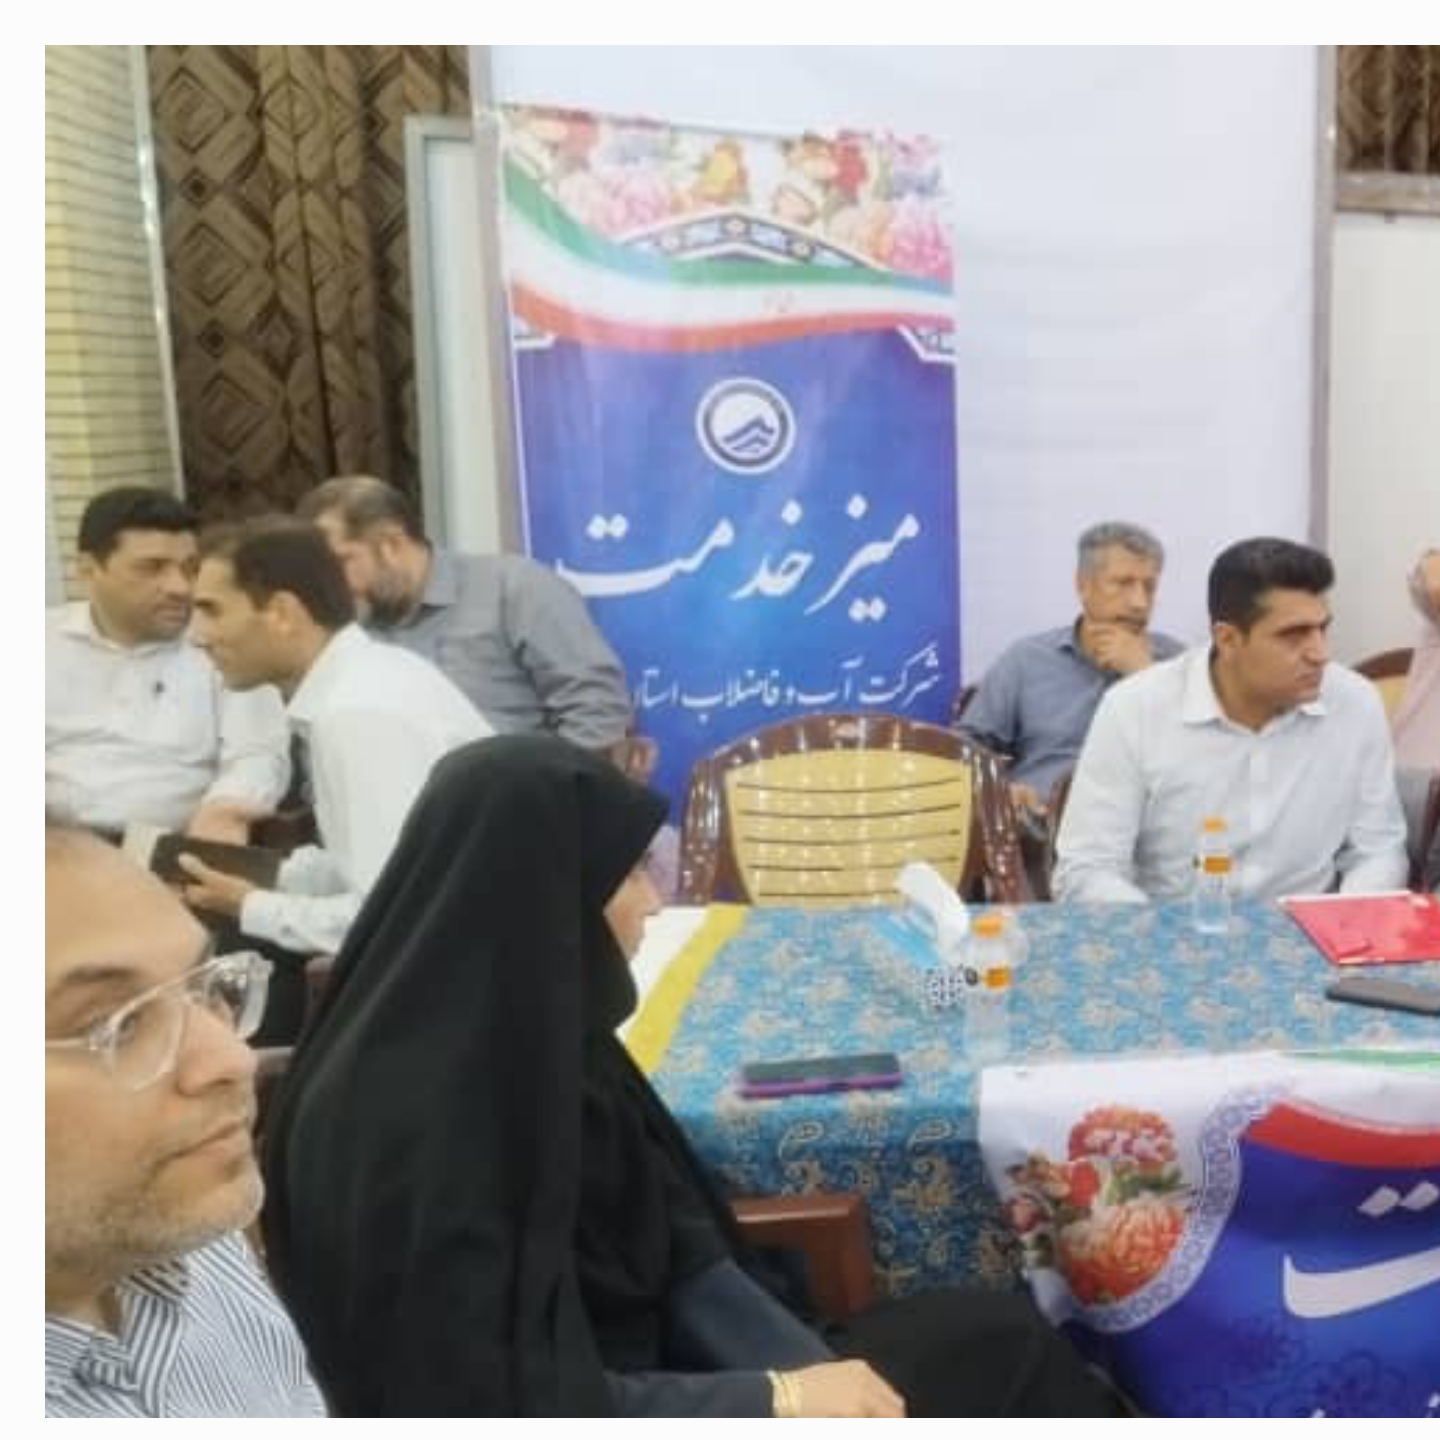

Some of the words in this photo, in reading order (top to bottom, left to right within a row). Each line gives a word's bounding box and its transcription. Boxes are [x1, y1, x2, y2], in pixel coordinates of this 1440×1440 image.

[554, 499, 814, 601] خدمت
[803, 493, 920, 622] میز
[634, 667, 679, 708] استا
[680, 668, 781, 724] فاضلاب
[797, 655, 865, 716] آب
[857, 641, 941, 708] شرکت
